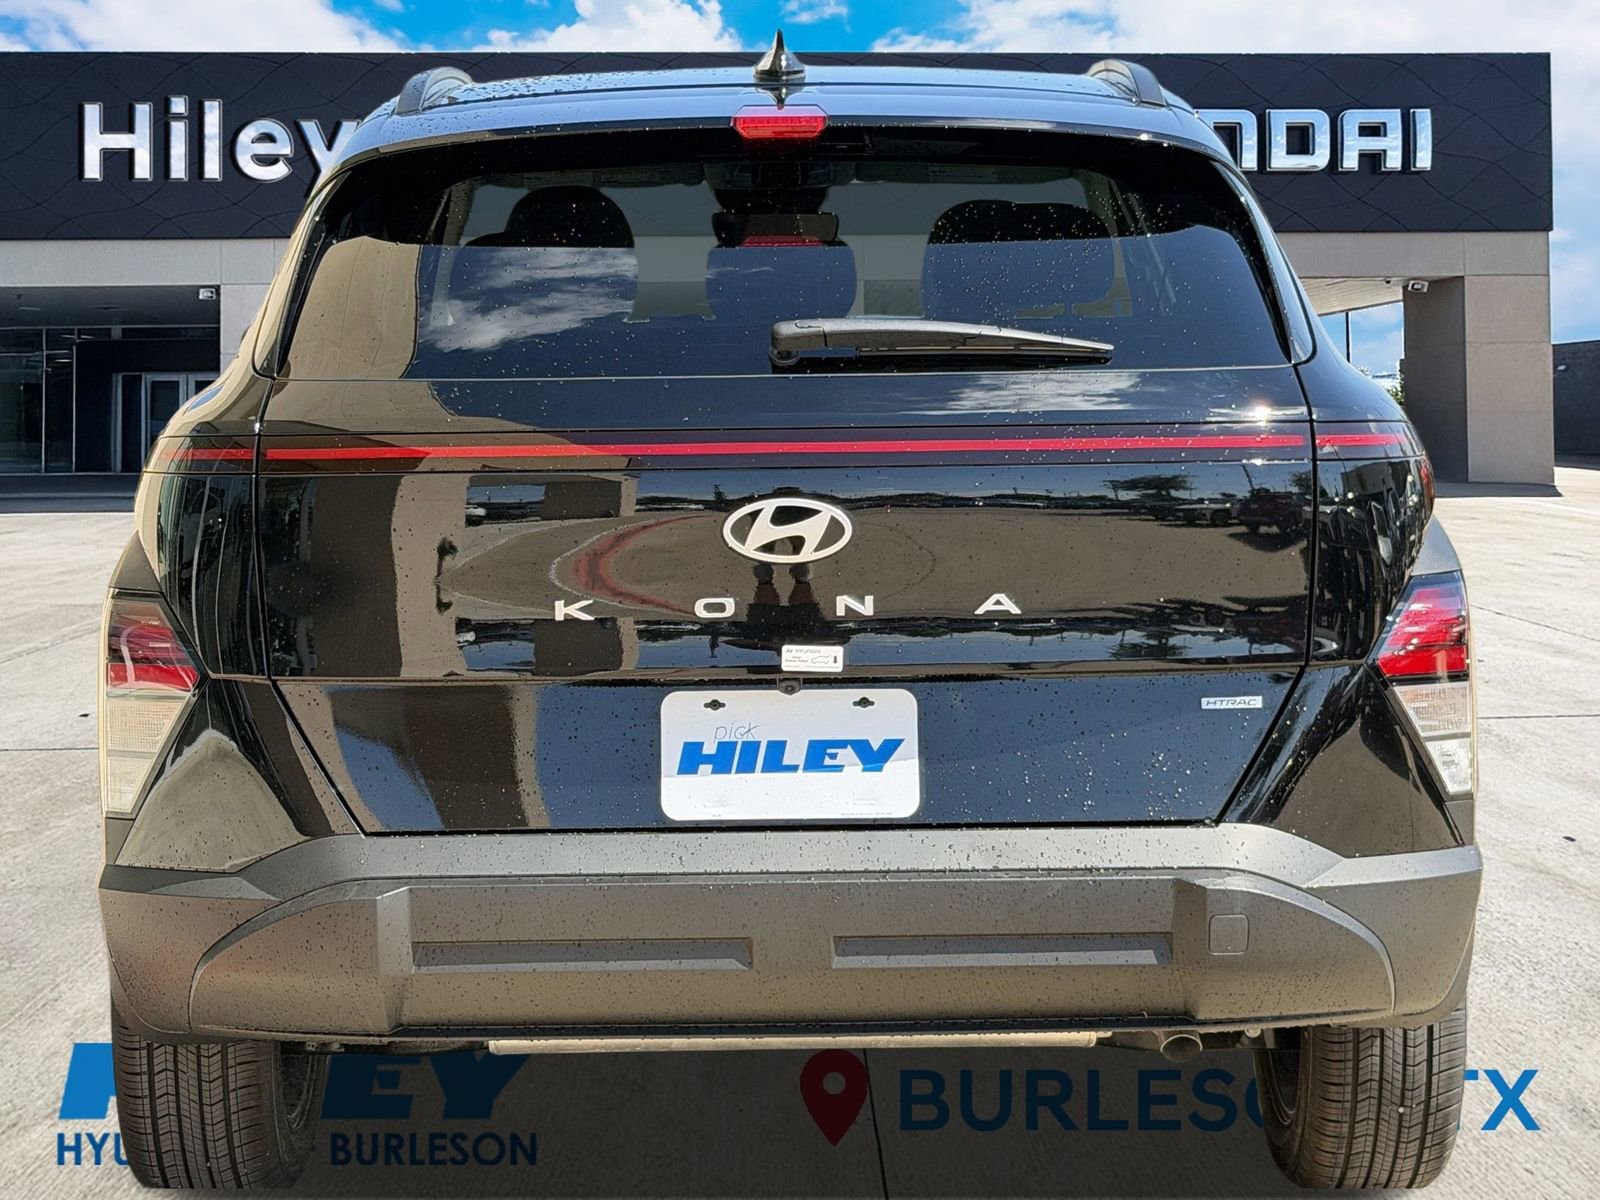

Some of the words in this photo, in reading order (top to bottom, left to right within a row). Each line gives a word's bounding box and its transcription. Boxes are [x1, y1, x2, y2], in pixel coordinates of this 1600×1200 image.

[80, 95, 358, 197] Hiley
[554, 593, 1021, 621] KONA
[1206, 698, 1257, 706] HTRAC
[713, 721, 760, 743] pick
[677, 738, 905, 775] HILEY
